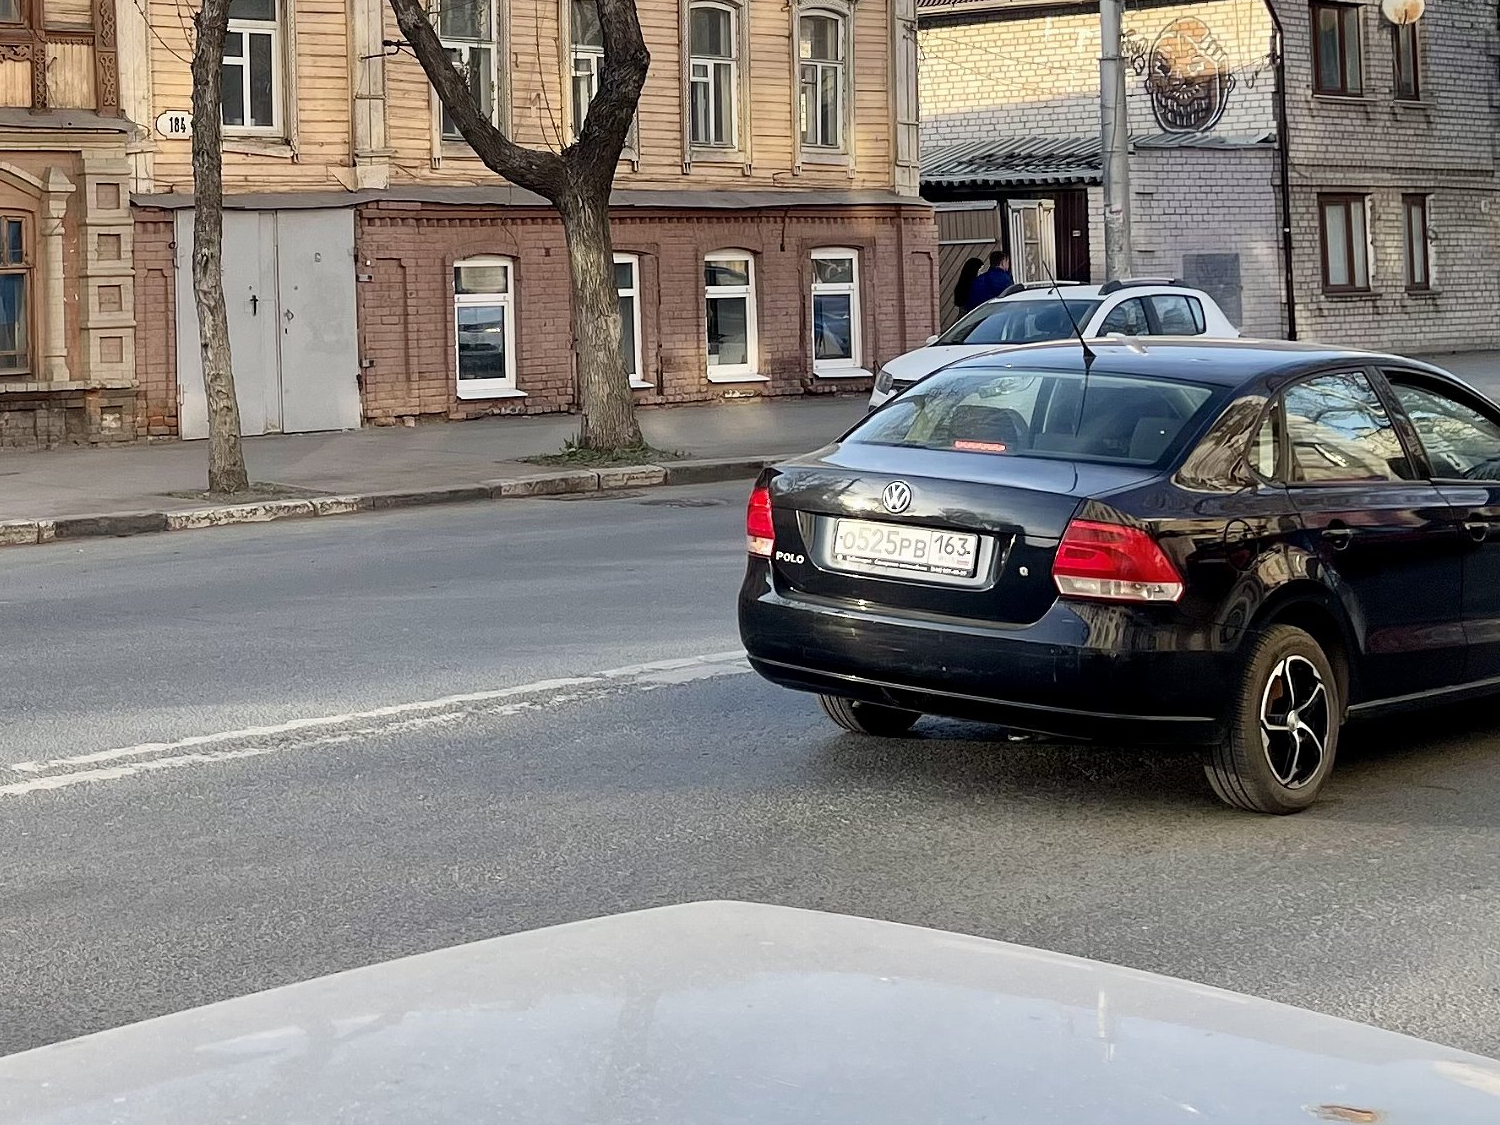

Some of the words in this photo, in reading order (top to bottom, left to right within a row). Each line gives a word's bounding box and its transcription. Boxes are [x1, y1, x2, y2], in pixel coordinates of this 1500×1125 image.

[169, 117, 186, 133] 184
[934, 534, 968, 556] 163
[775, 550, 805, 564] POLO
